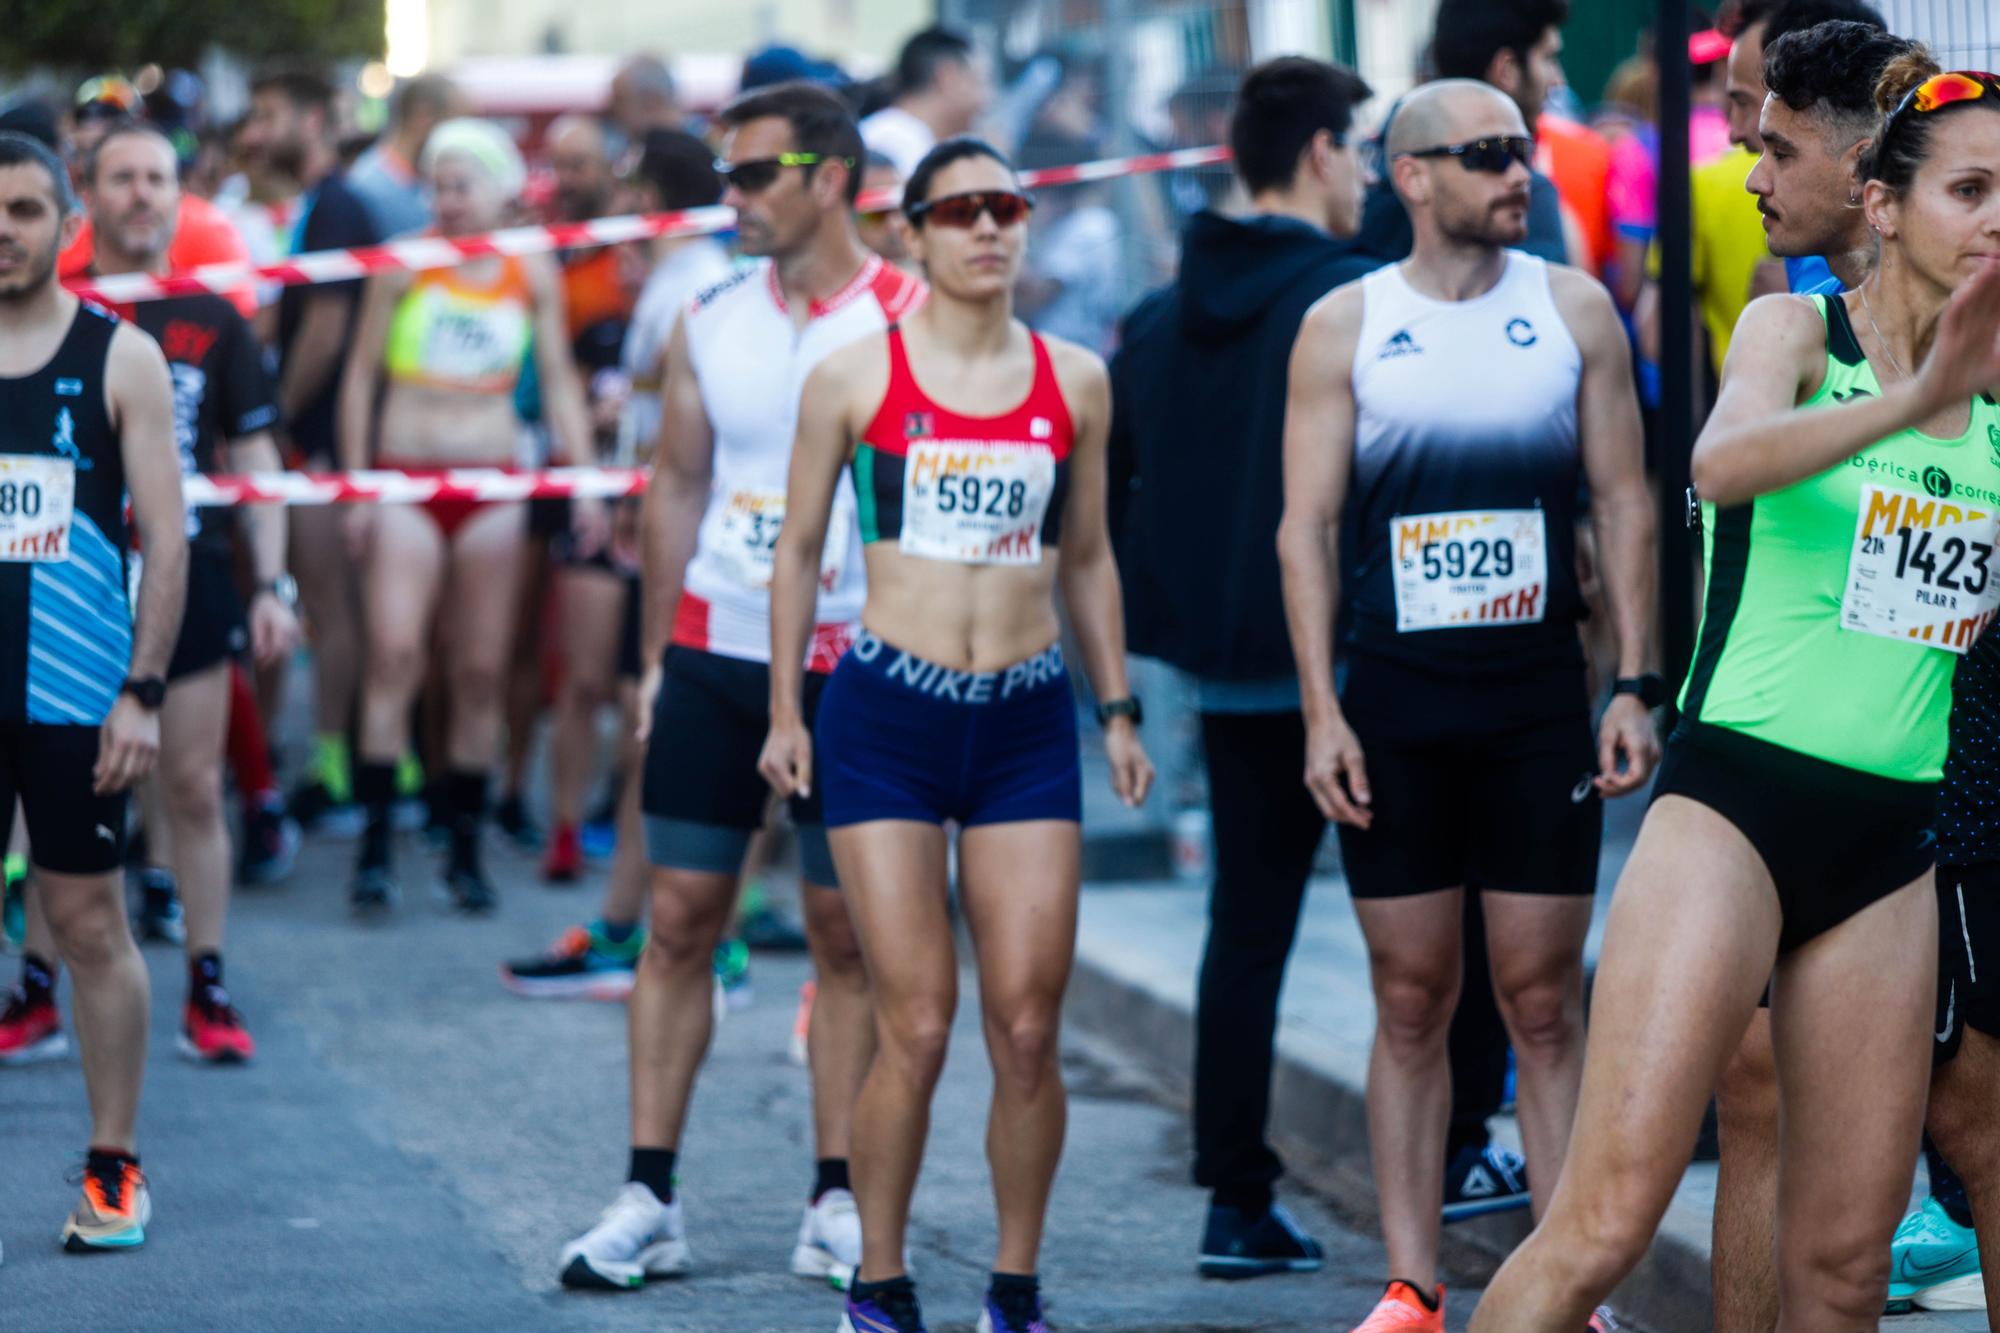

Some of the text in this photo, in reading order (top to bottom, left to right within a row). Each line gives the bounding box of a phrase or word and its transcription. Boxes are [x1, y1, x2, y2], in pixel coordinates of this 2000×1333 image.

[938, 474, 1027, 519] 5928
[1422, 538, 1514, 581] 5929
[1894, 525, 1994, 596] 1423
[1915, 588, 1958, 610] PILAR R
[885, 651, 998, 703] NIKE
[1000, 640, 1065, 698] PRO
